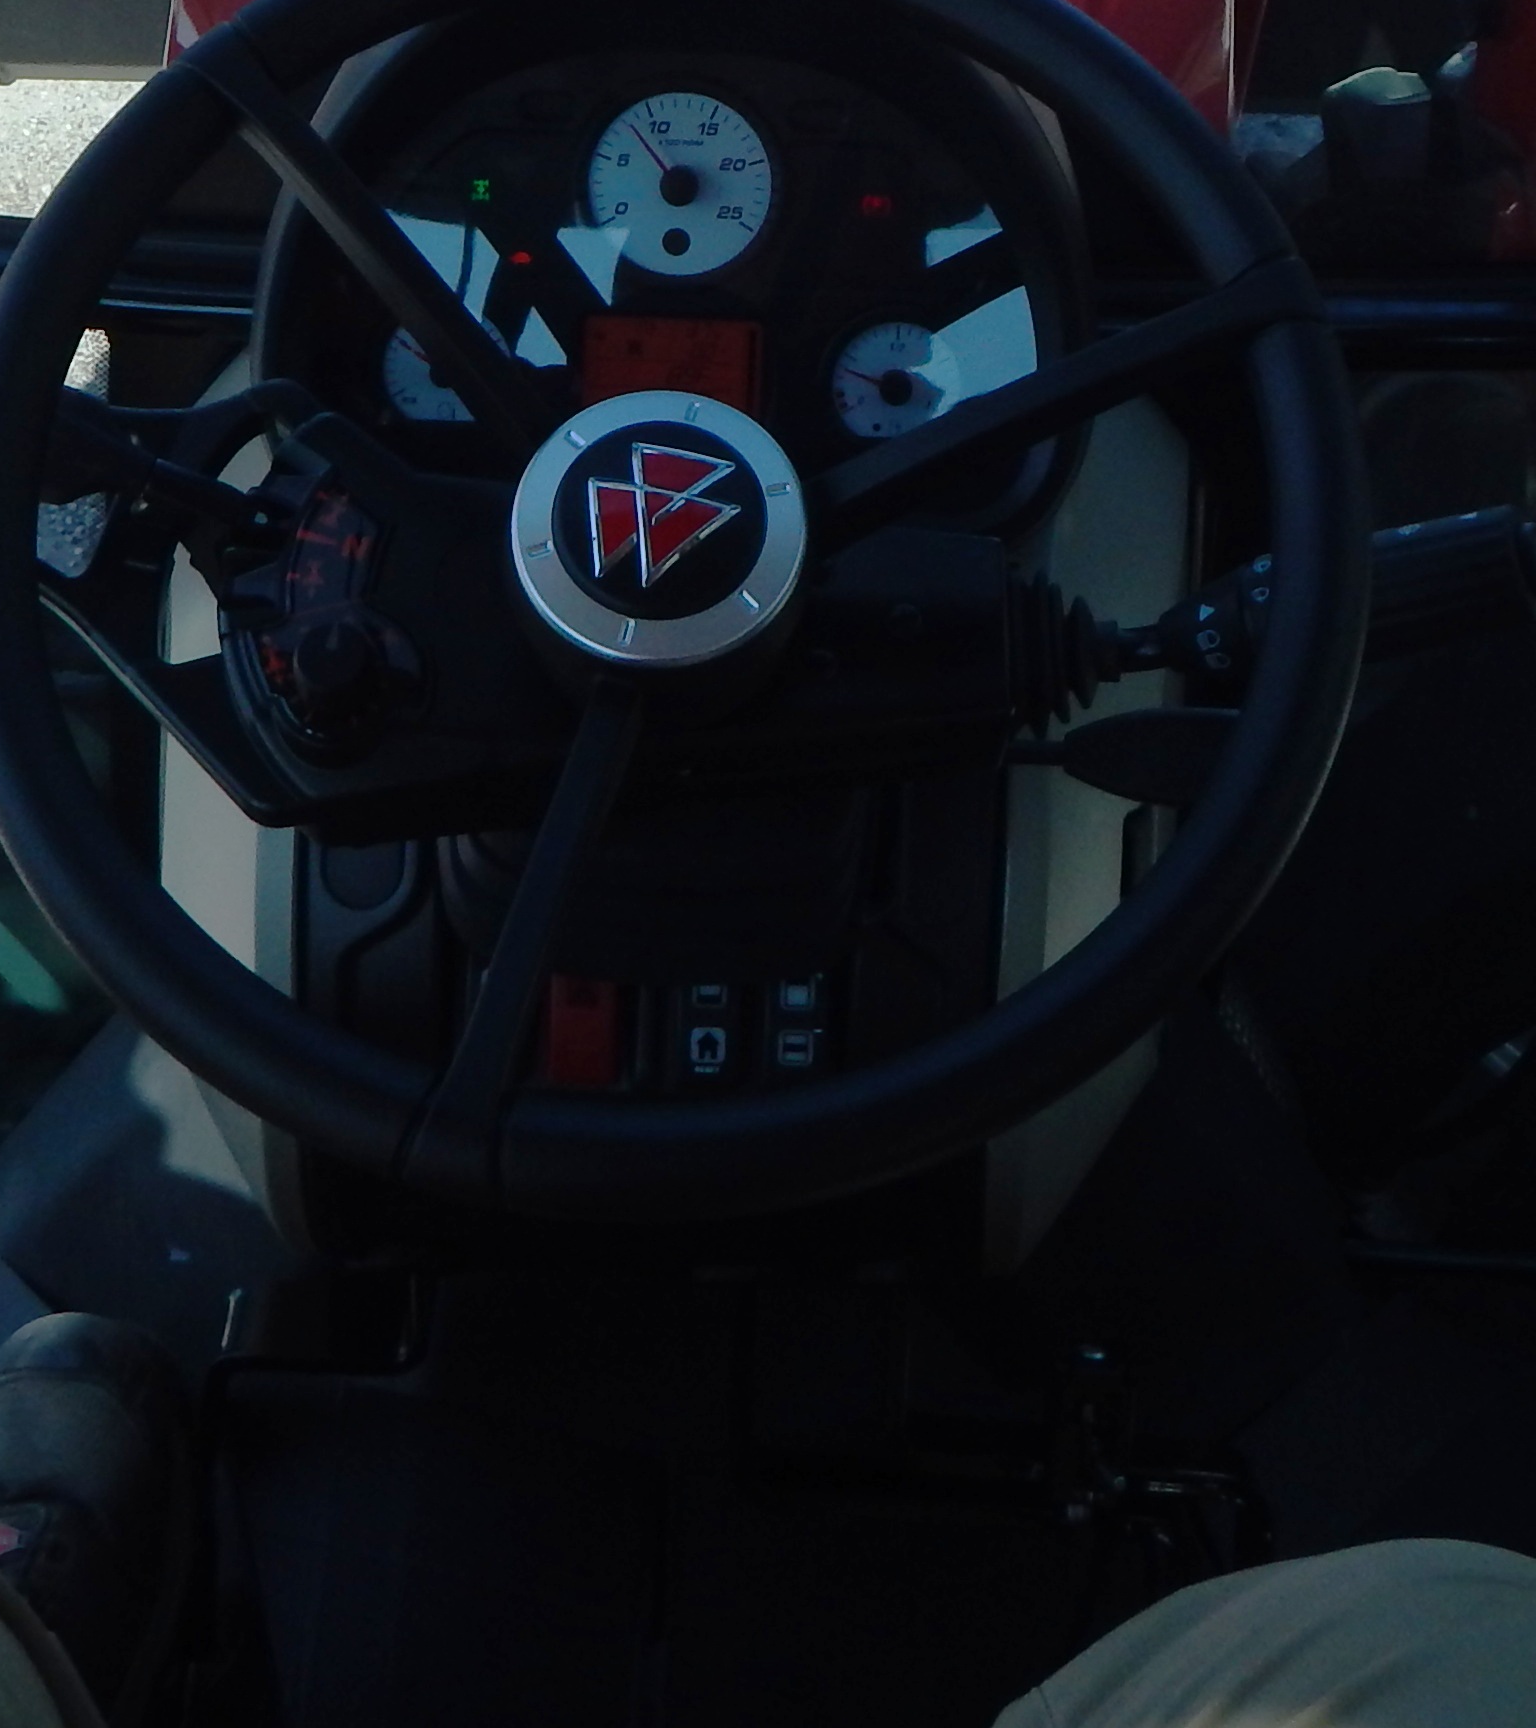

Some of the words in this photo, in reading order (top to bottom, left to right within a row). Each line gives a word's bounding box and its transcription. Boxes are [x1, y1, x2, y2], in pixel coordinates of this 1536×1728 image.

[649, 120, 671, 134] 10
[697, 123, 719, 136] 15
[616, 153, 631, 167] 5
[719, 157, 746, 171] 20
[615, 201, 629, 215] 0
[716, 206, 743, 219] 25
